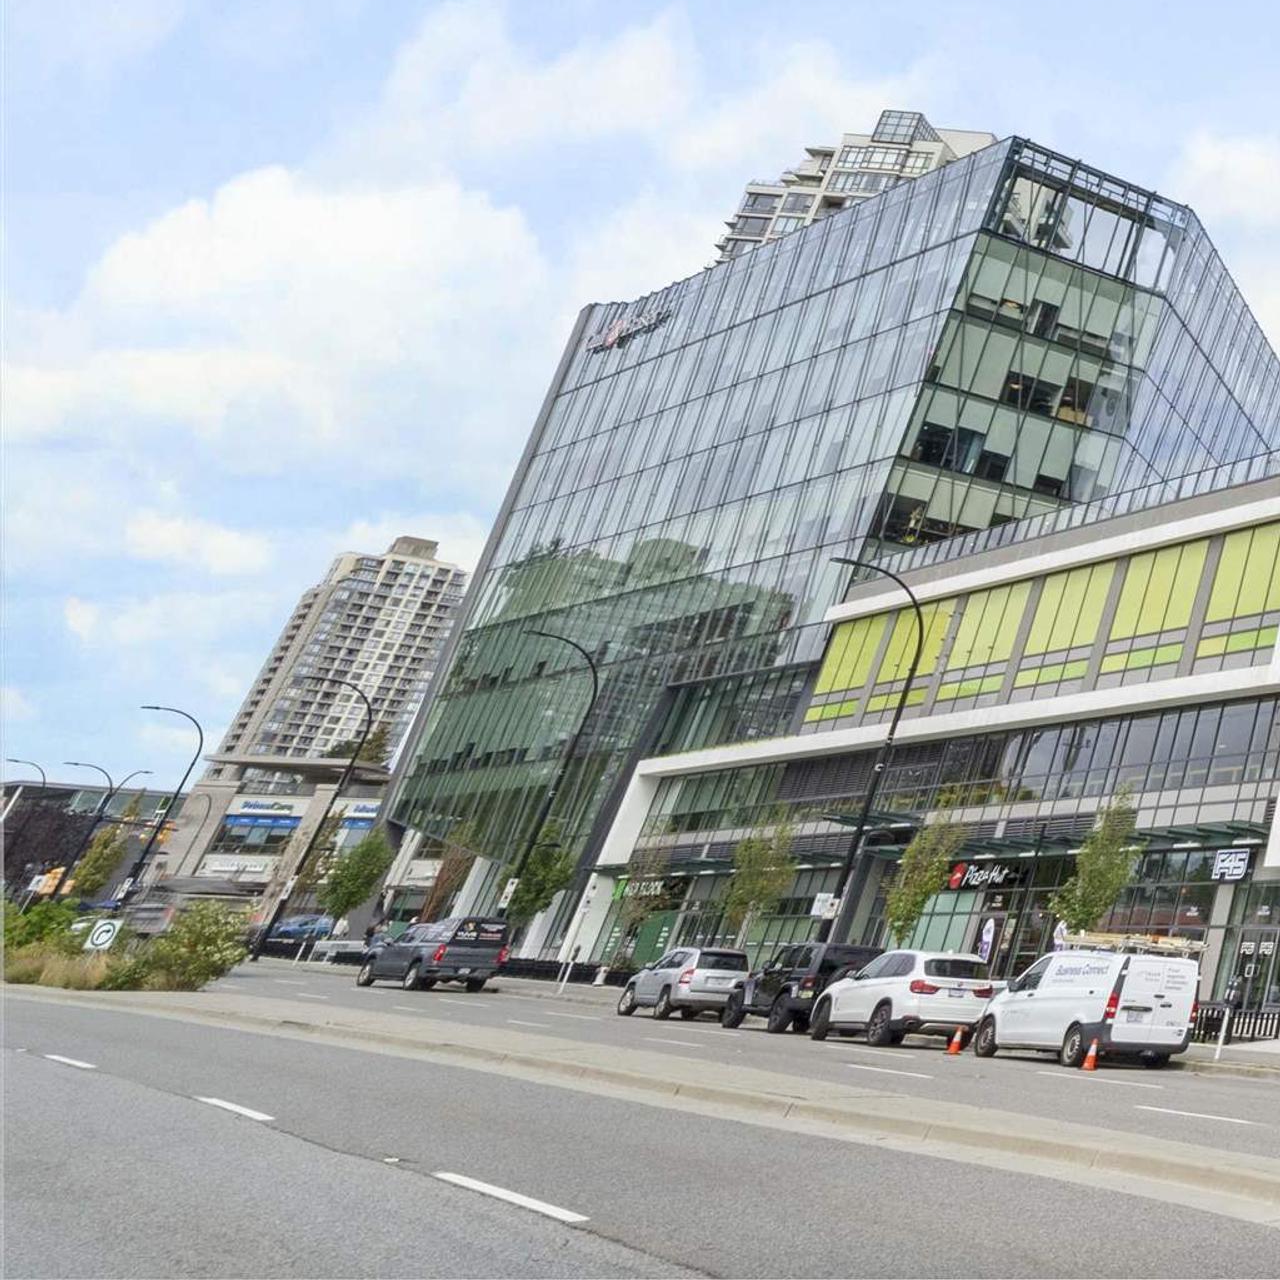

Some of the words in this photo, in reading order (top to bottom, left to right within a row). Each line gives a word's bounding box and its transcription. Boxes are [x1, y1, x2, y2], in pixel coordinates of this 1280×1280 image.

[961, 864, 989, 887] Pizza
[987, 865, 1010, 884] Hut
[1211, 848, 1250, 879] F45
